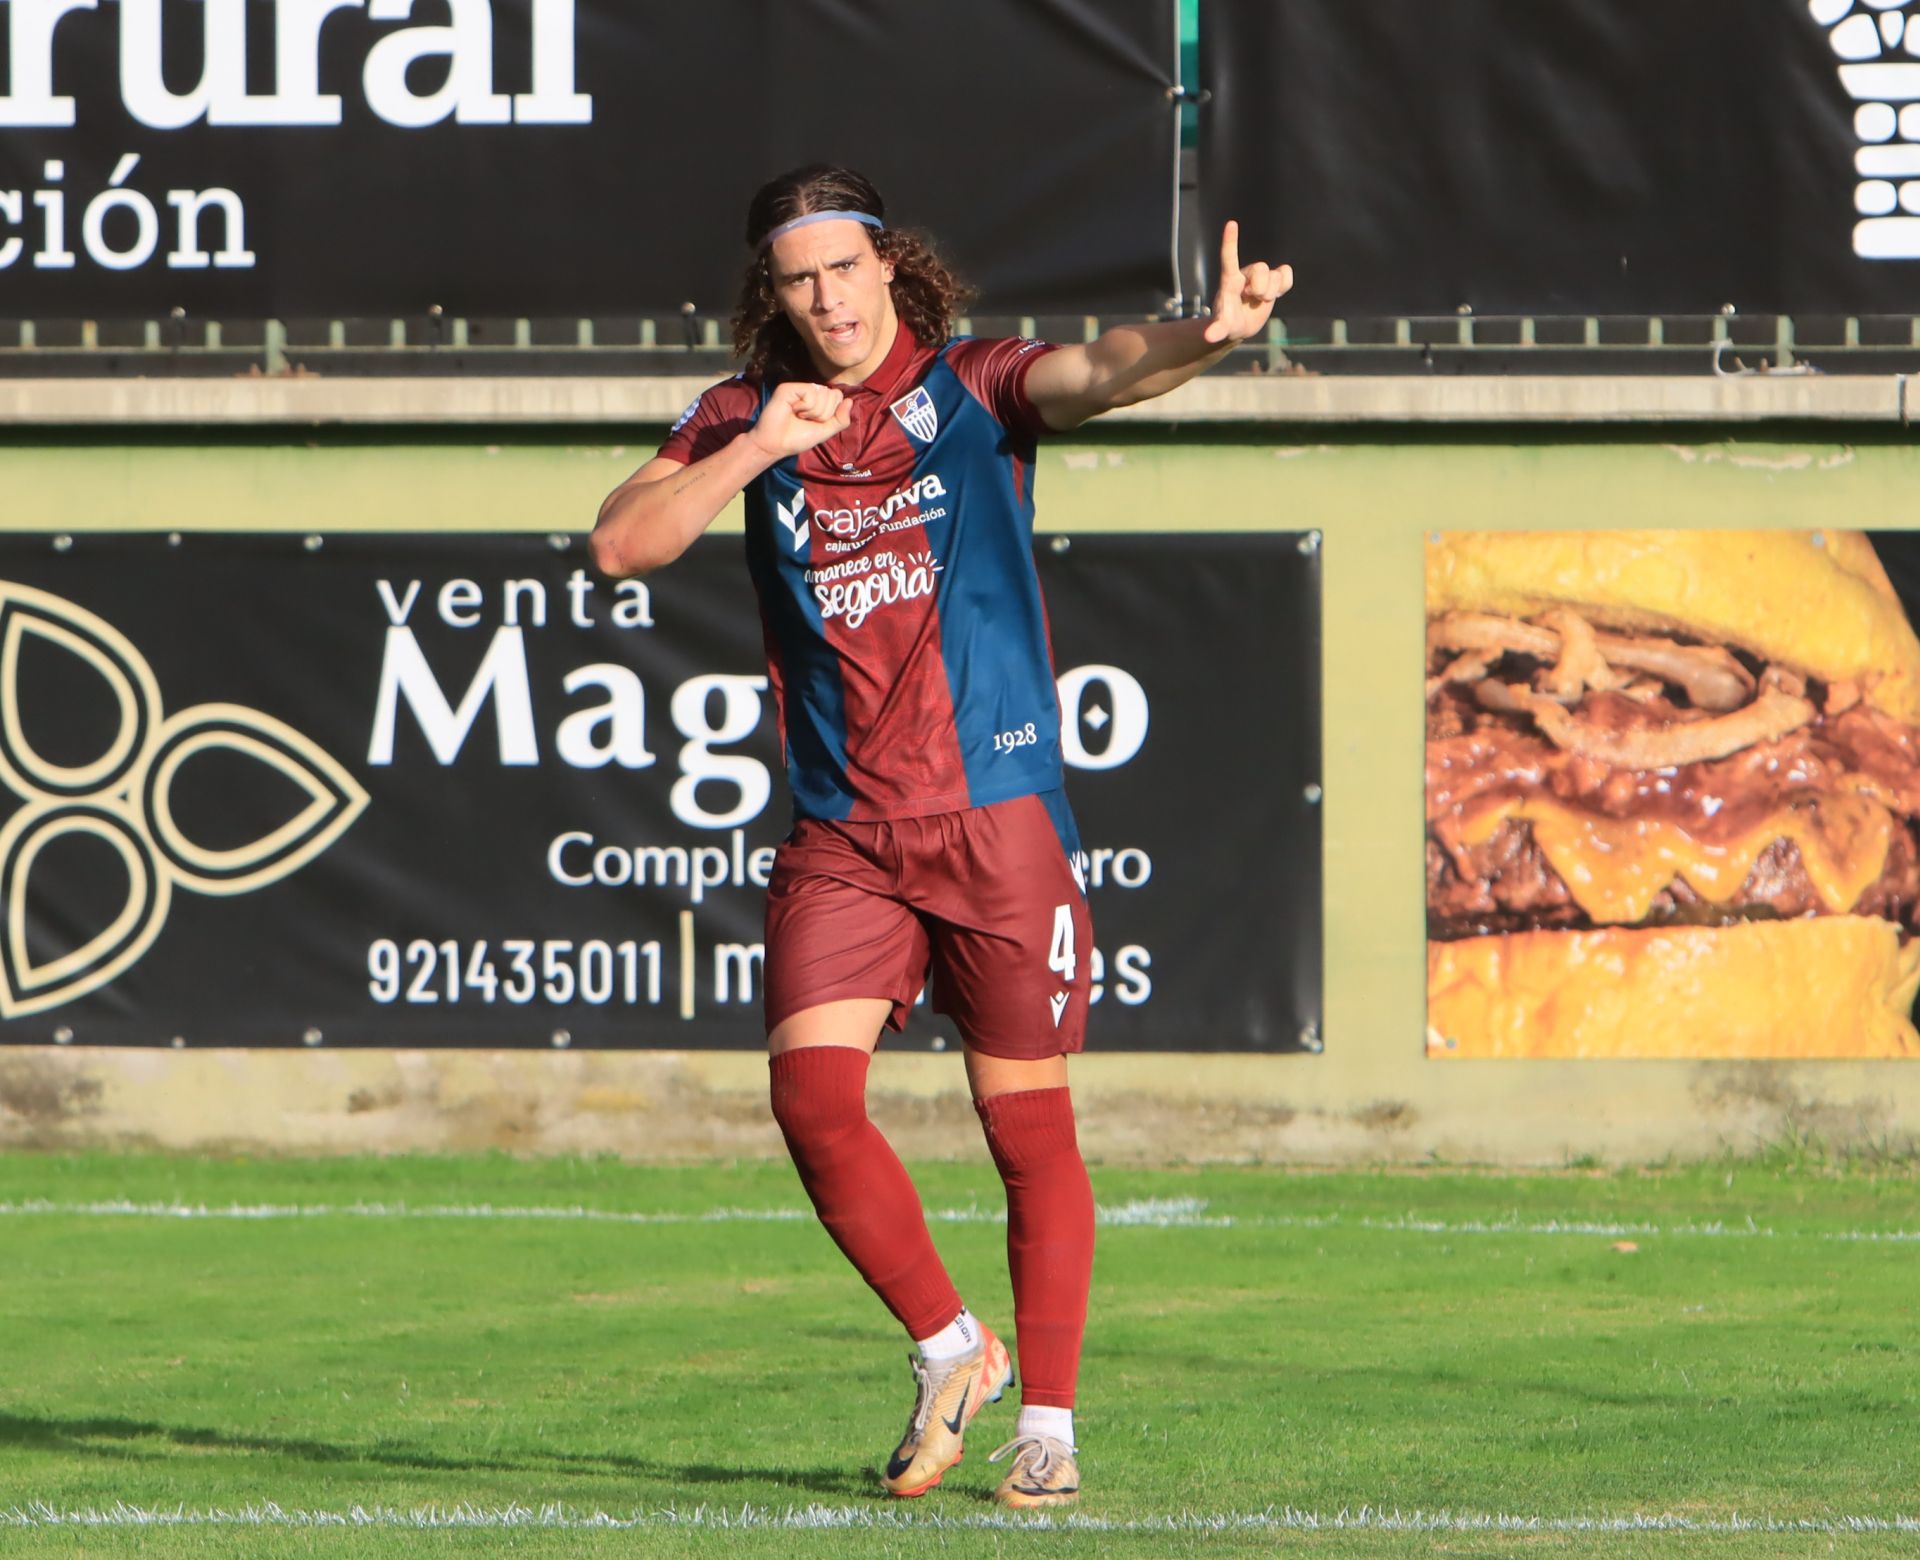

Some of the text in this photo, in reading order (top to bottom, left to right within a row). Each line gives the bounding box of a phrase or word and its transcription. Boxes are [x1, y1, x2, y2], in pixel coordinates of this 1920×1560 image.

[814, 473, 947, 539] cajaviva
[878, 506, 947, 534] Fundación
[375, 568, 655, 628] venta
[804, 551, 897, 584] amanece en
[814, 560, 936, 629] segovia
[366, 625, 1150, 830] Mago
[993, 722, 1038, 755] 1928
[547, 828, 777, 903] Comple
[367, 938, 662, 1003] 921435011
[1048, 903, 1076, 981] 4
